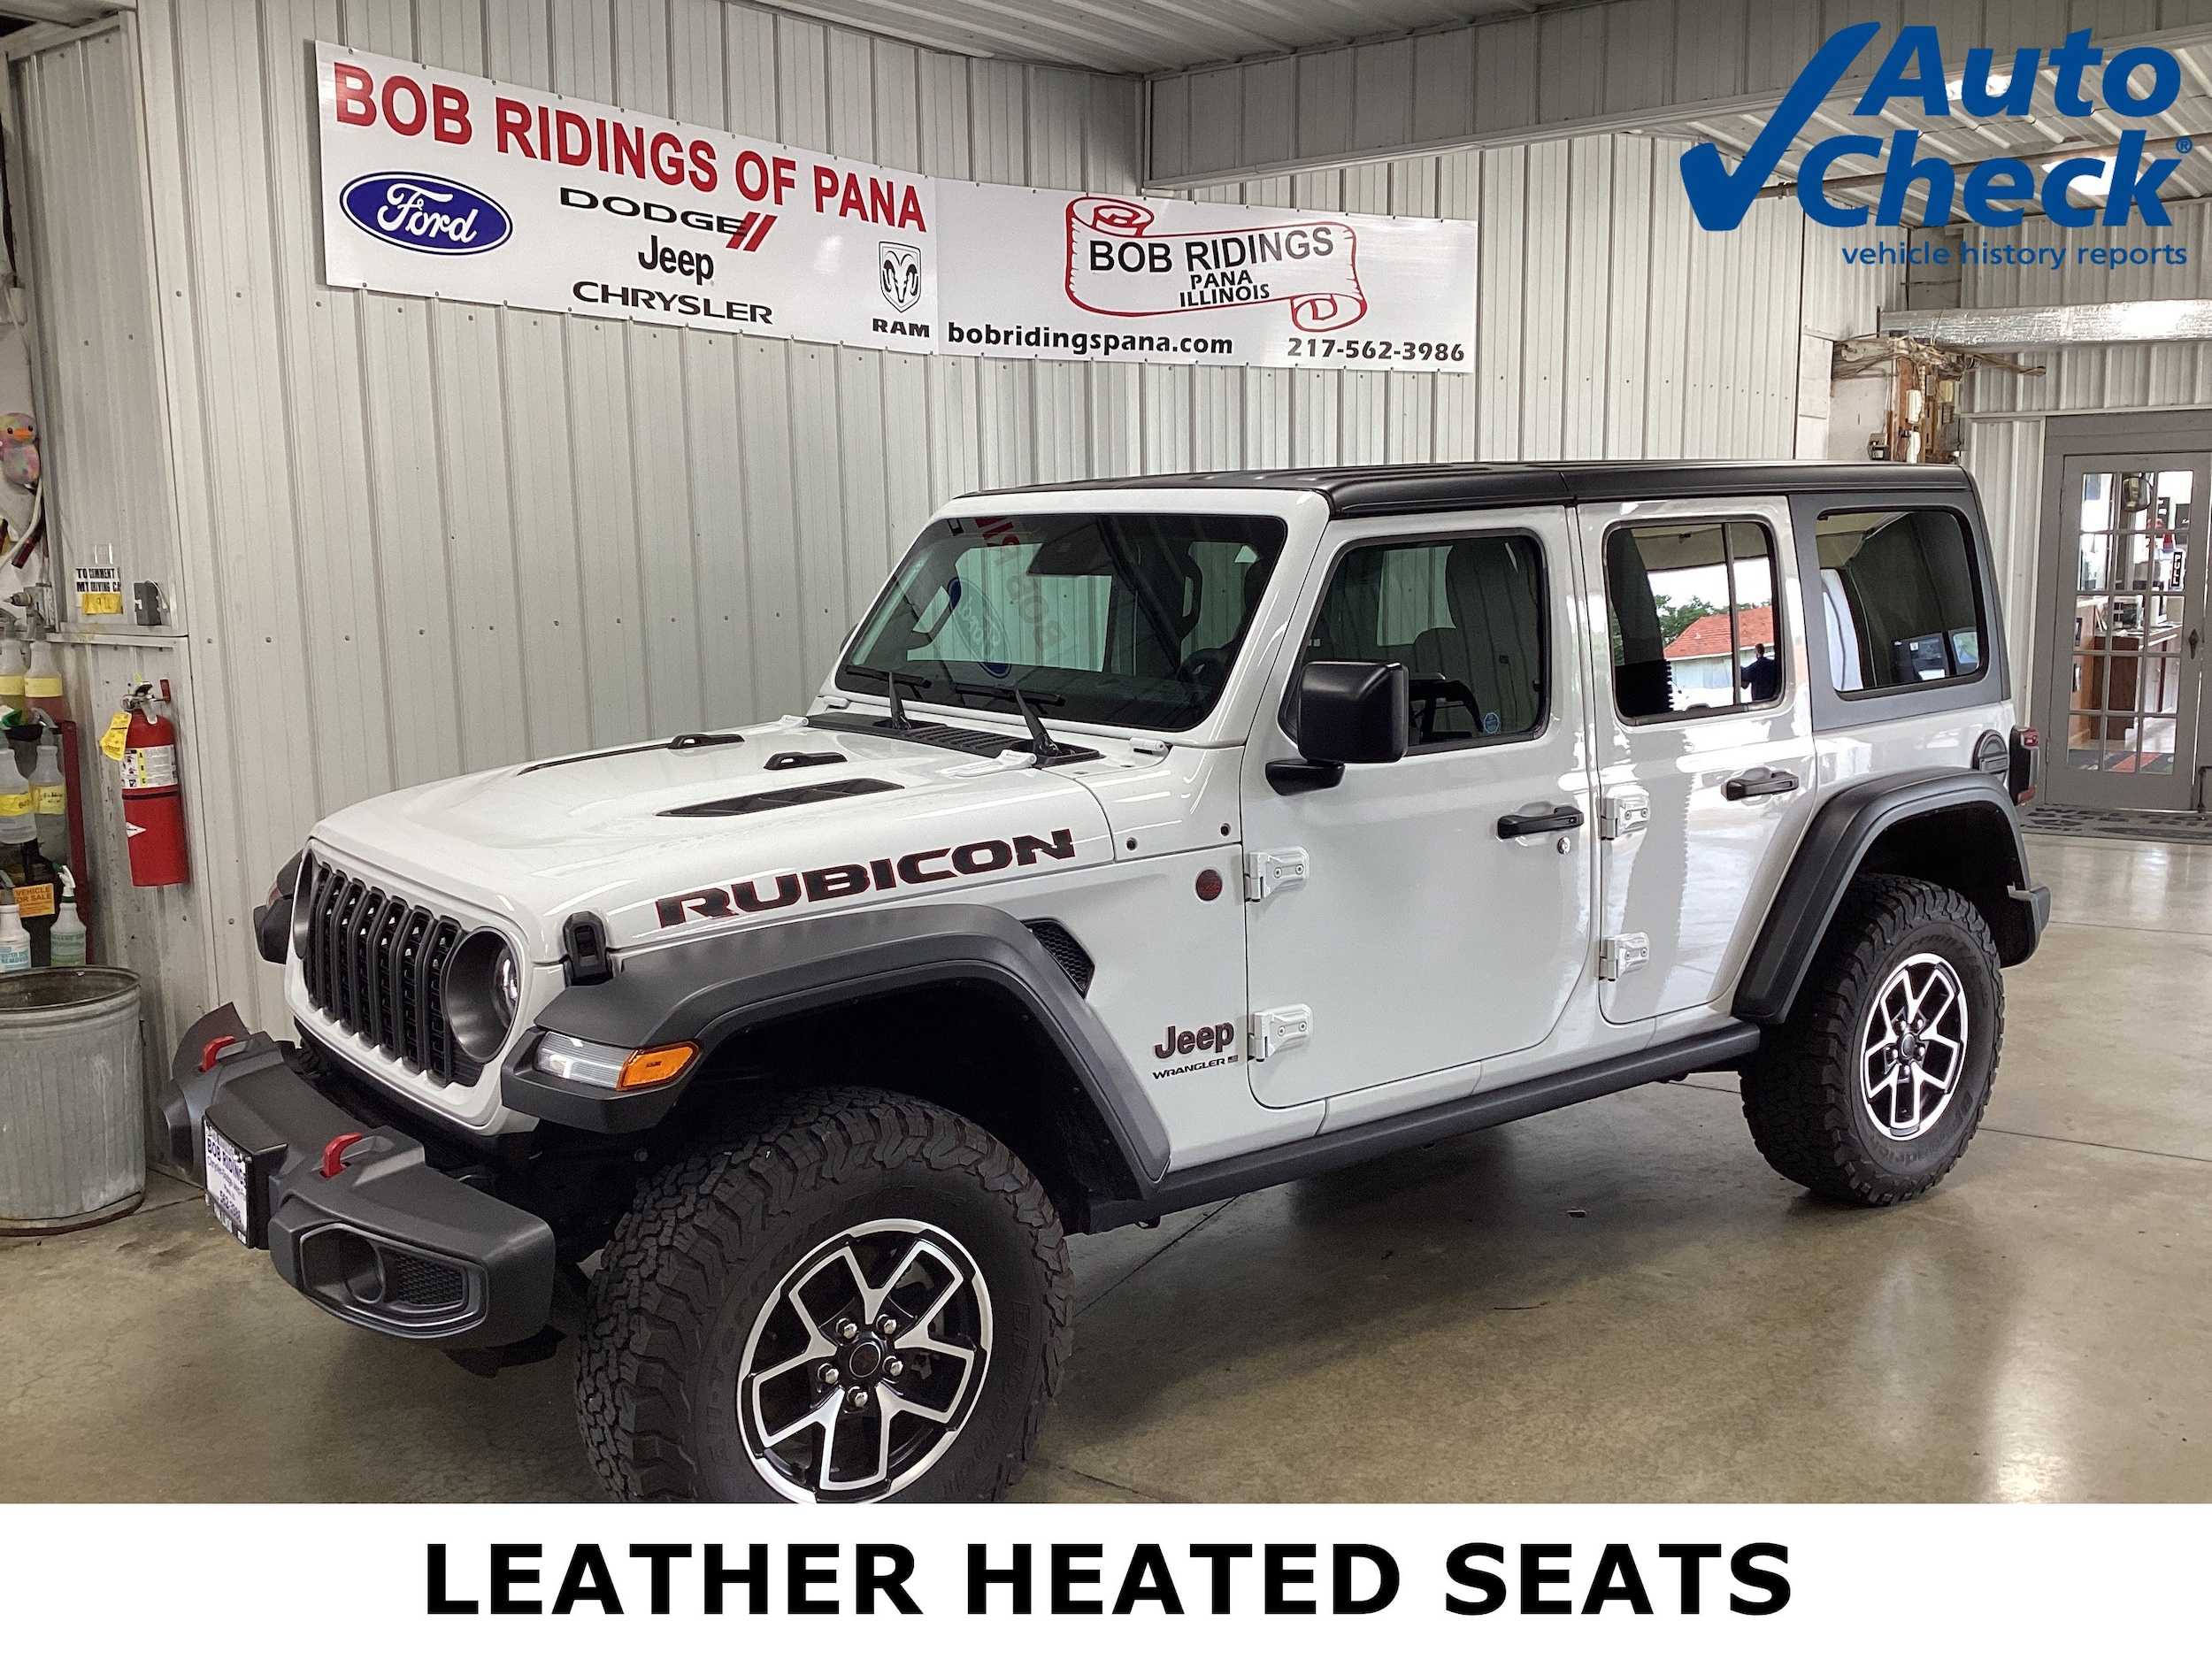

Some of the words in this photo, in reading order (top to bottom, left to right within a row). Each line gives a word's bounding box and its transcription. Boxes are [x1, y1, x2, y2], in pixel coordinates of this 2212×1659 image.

[334, 63, 472, 146] BOB
[495, 96, 718, 193] RIDINGS
[735, 150, 796, 206] OF
[813, 165, 926, 233] PANA
[376, 182, 478, 244] Ford
[560, 187, 756, 242] DODGE
[638, 234, 714, 286] Jeep
[1089, 239, 1173, 273] BOB
[1187, 227, 1335, 273] RIDINGS
[1179, 284, 1271, 307] ILLINOIS
[1190, 270, 1253, 291] PANA
[572, 280, 773, 325] CHRYSLER
[872, 318, 930, 338] RAM
[949, 322, 1233, 355] bobridingspana.com
[1288, 338, 1465, 362] 217-562-3986
[76, 568, 88, 580] TO
[2172, 554, 2182, 585] PULL
[76, 582, 88, 592] MY
[16, 886, 50, 896] VEHICLE
[655, 827, 1075, 928] RUBICON
[30, 893, 52, 902] SALE
[1154, 1022, 1235, 1059] Jeep
[1152, 1057, 1226, 1079] WRANGLER
[207, 1137, 221, 1162] BOB
